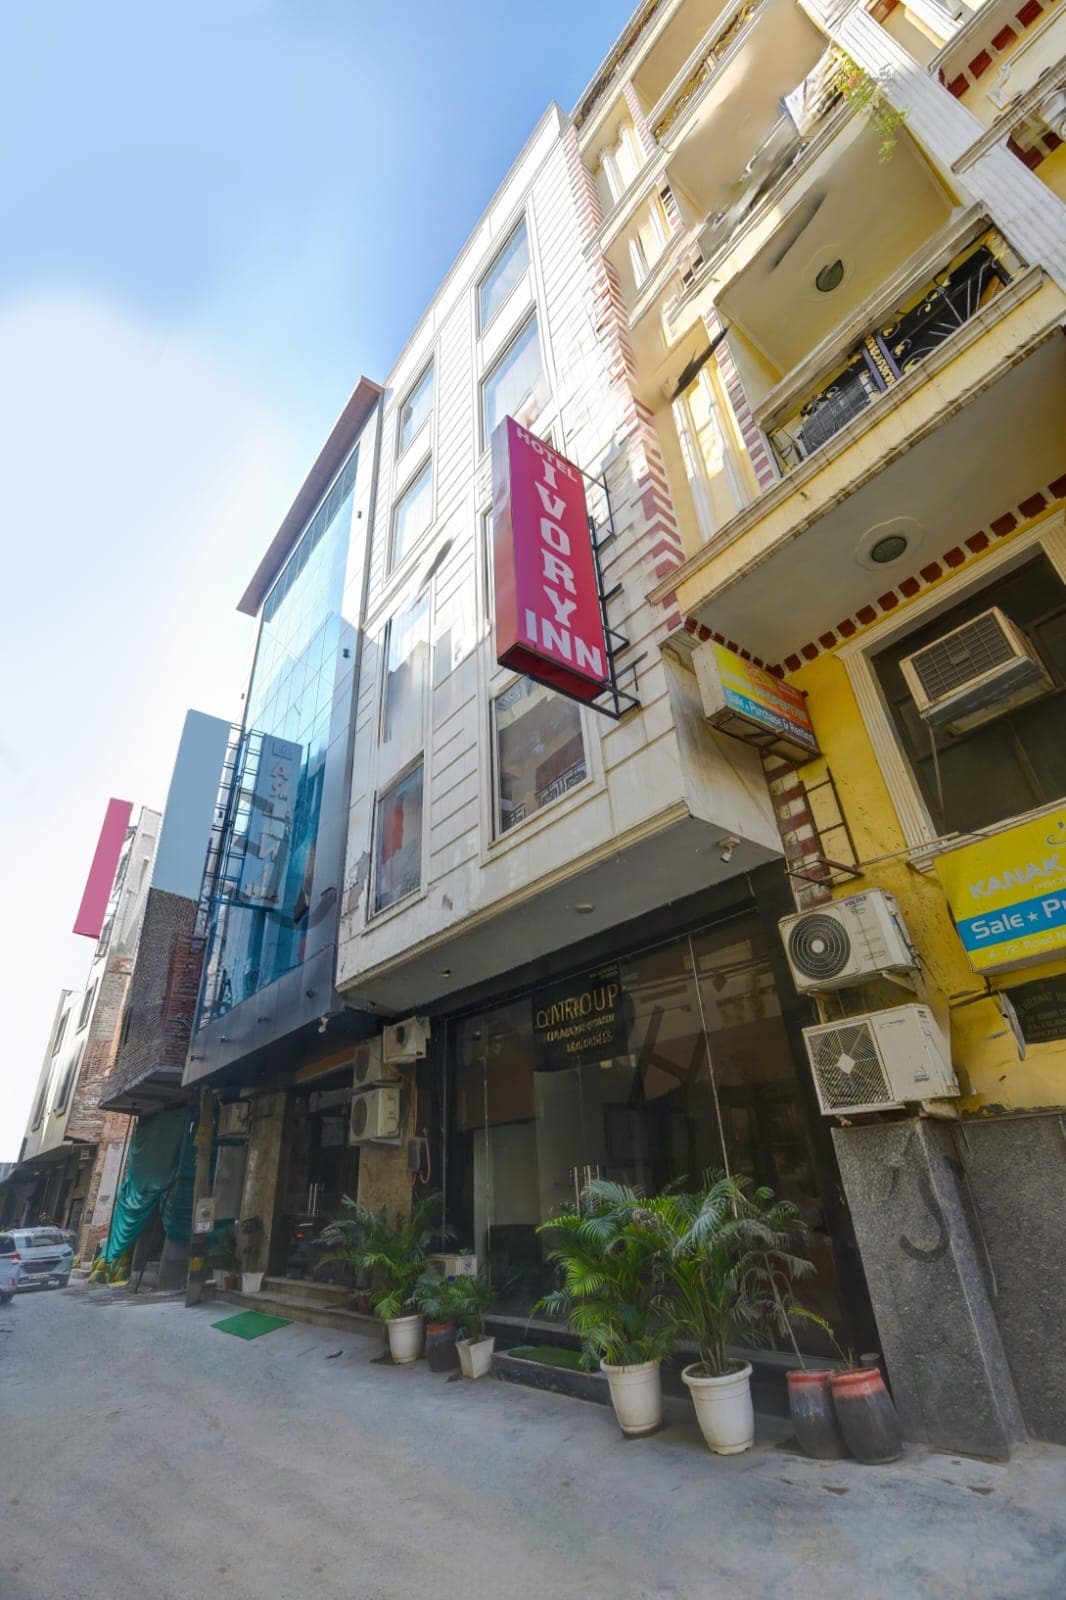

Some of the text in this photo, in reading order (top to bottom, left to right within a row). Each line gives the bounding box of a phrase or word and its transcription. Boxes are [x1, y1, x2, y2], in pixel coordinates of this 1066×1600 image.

[516, 427, 578, 482] HOTEL
[535, 459, 577, 628] IVORY
[525, 608, 603, 676] INN
[968, 853, 1066, 900] KANAK
[971, 914, 1024, 940] Sale
